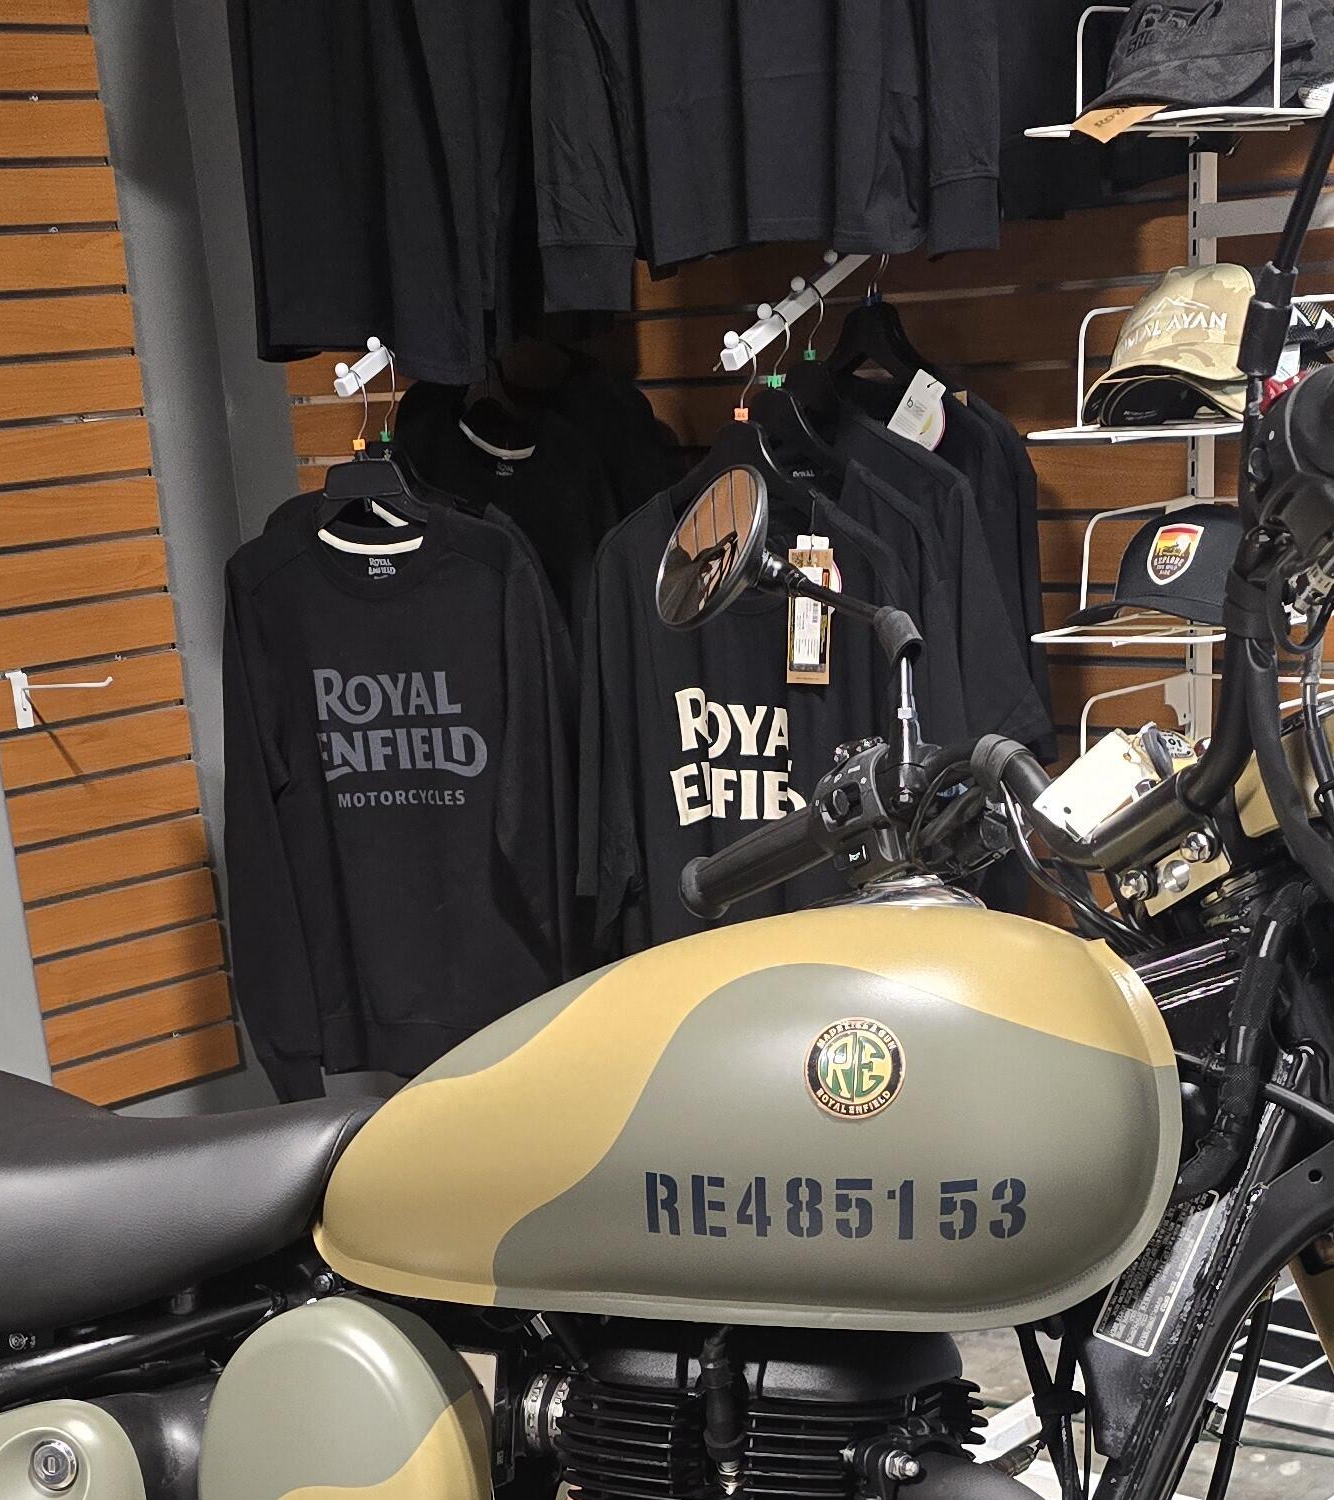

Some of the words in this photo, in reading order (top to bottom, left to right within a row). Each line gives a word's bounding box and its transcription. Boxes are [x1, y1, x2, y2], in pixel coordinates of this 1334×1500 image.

[312, 668, 462, 725] ROYAL
[316, 726, 488, 782] ENFIELD
[337, 788, 466, 808] MOTORCYCLES
[816, 1024, 846, 1049] MADE
[877, 1029, 897, 1050] GUN
[825, 1031, 886, 1101] RE
[816, 1087, 847, 1114] ROYAL
[848, 1090, 892, 1114] ENFIELD
[644, 1171, 1028, 1241] RE485153
